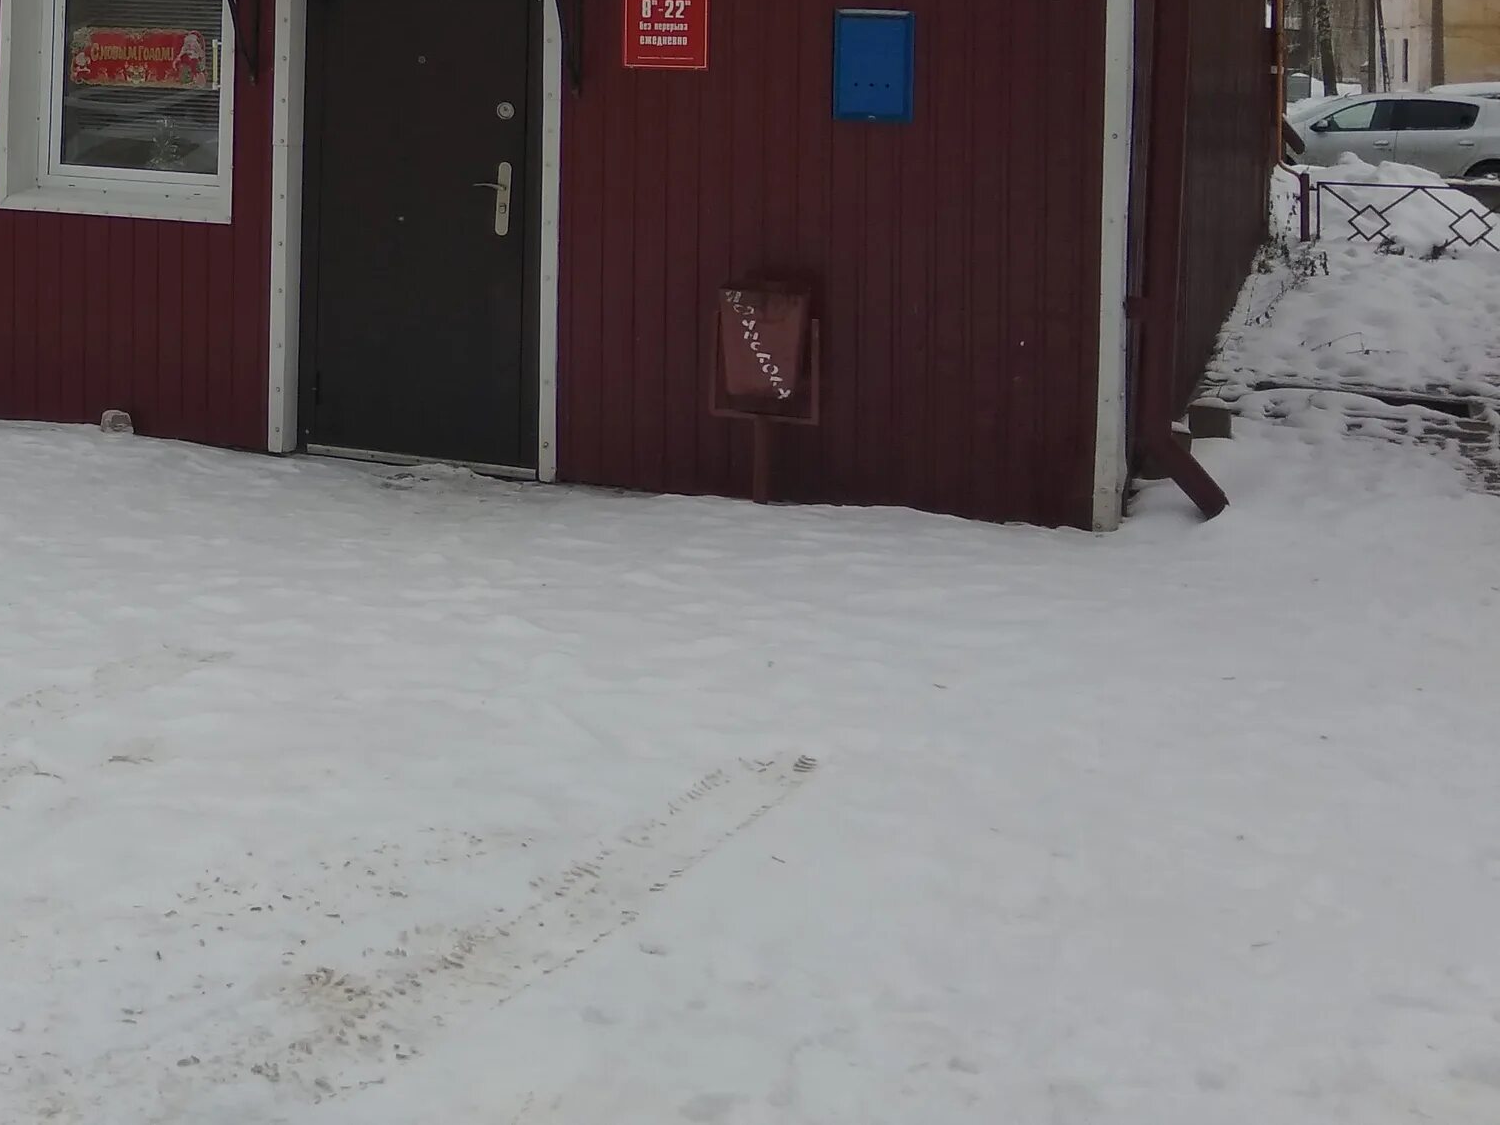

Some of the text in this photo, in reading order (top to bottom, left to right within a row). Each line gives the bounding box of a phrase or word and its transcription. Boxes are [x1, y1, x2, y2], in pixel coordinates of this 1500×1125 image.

[639, 20, 688, 33] без перерыва
[639, 35, 688, 46] ежедневно
